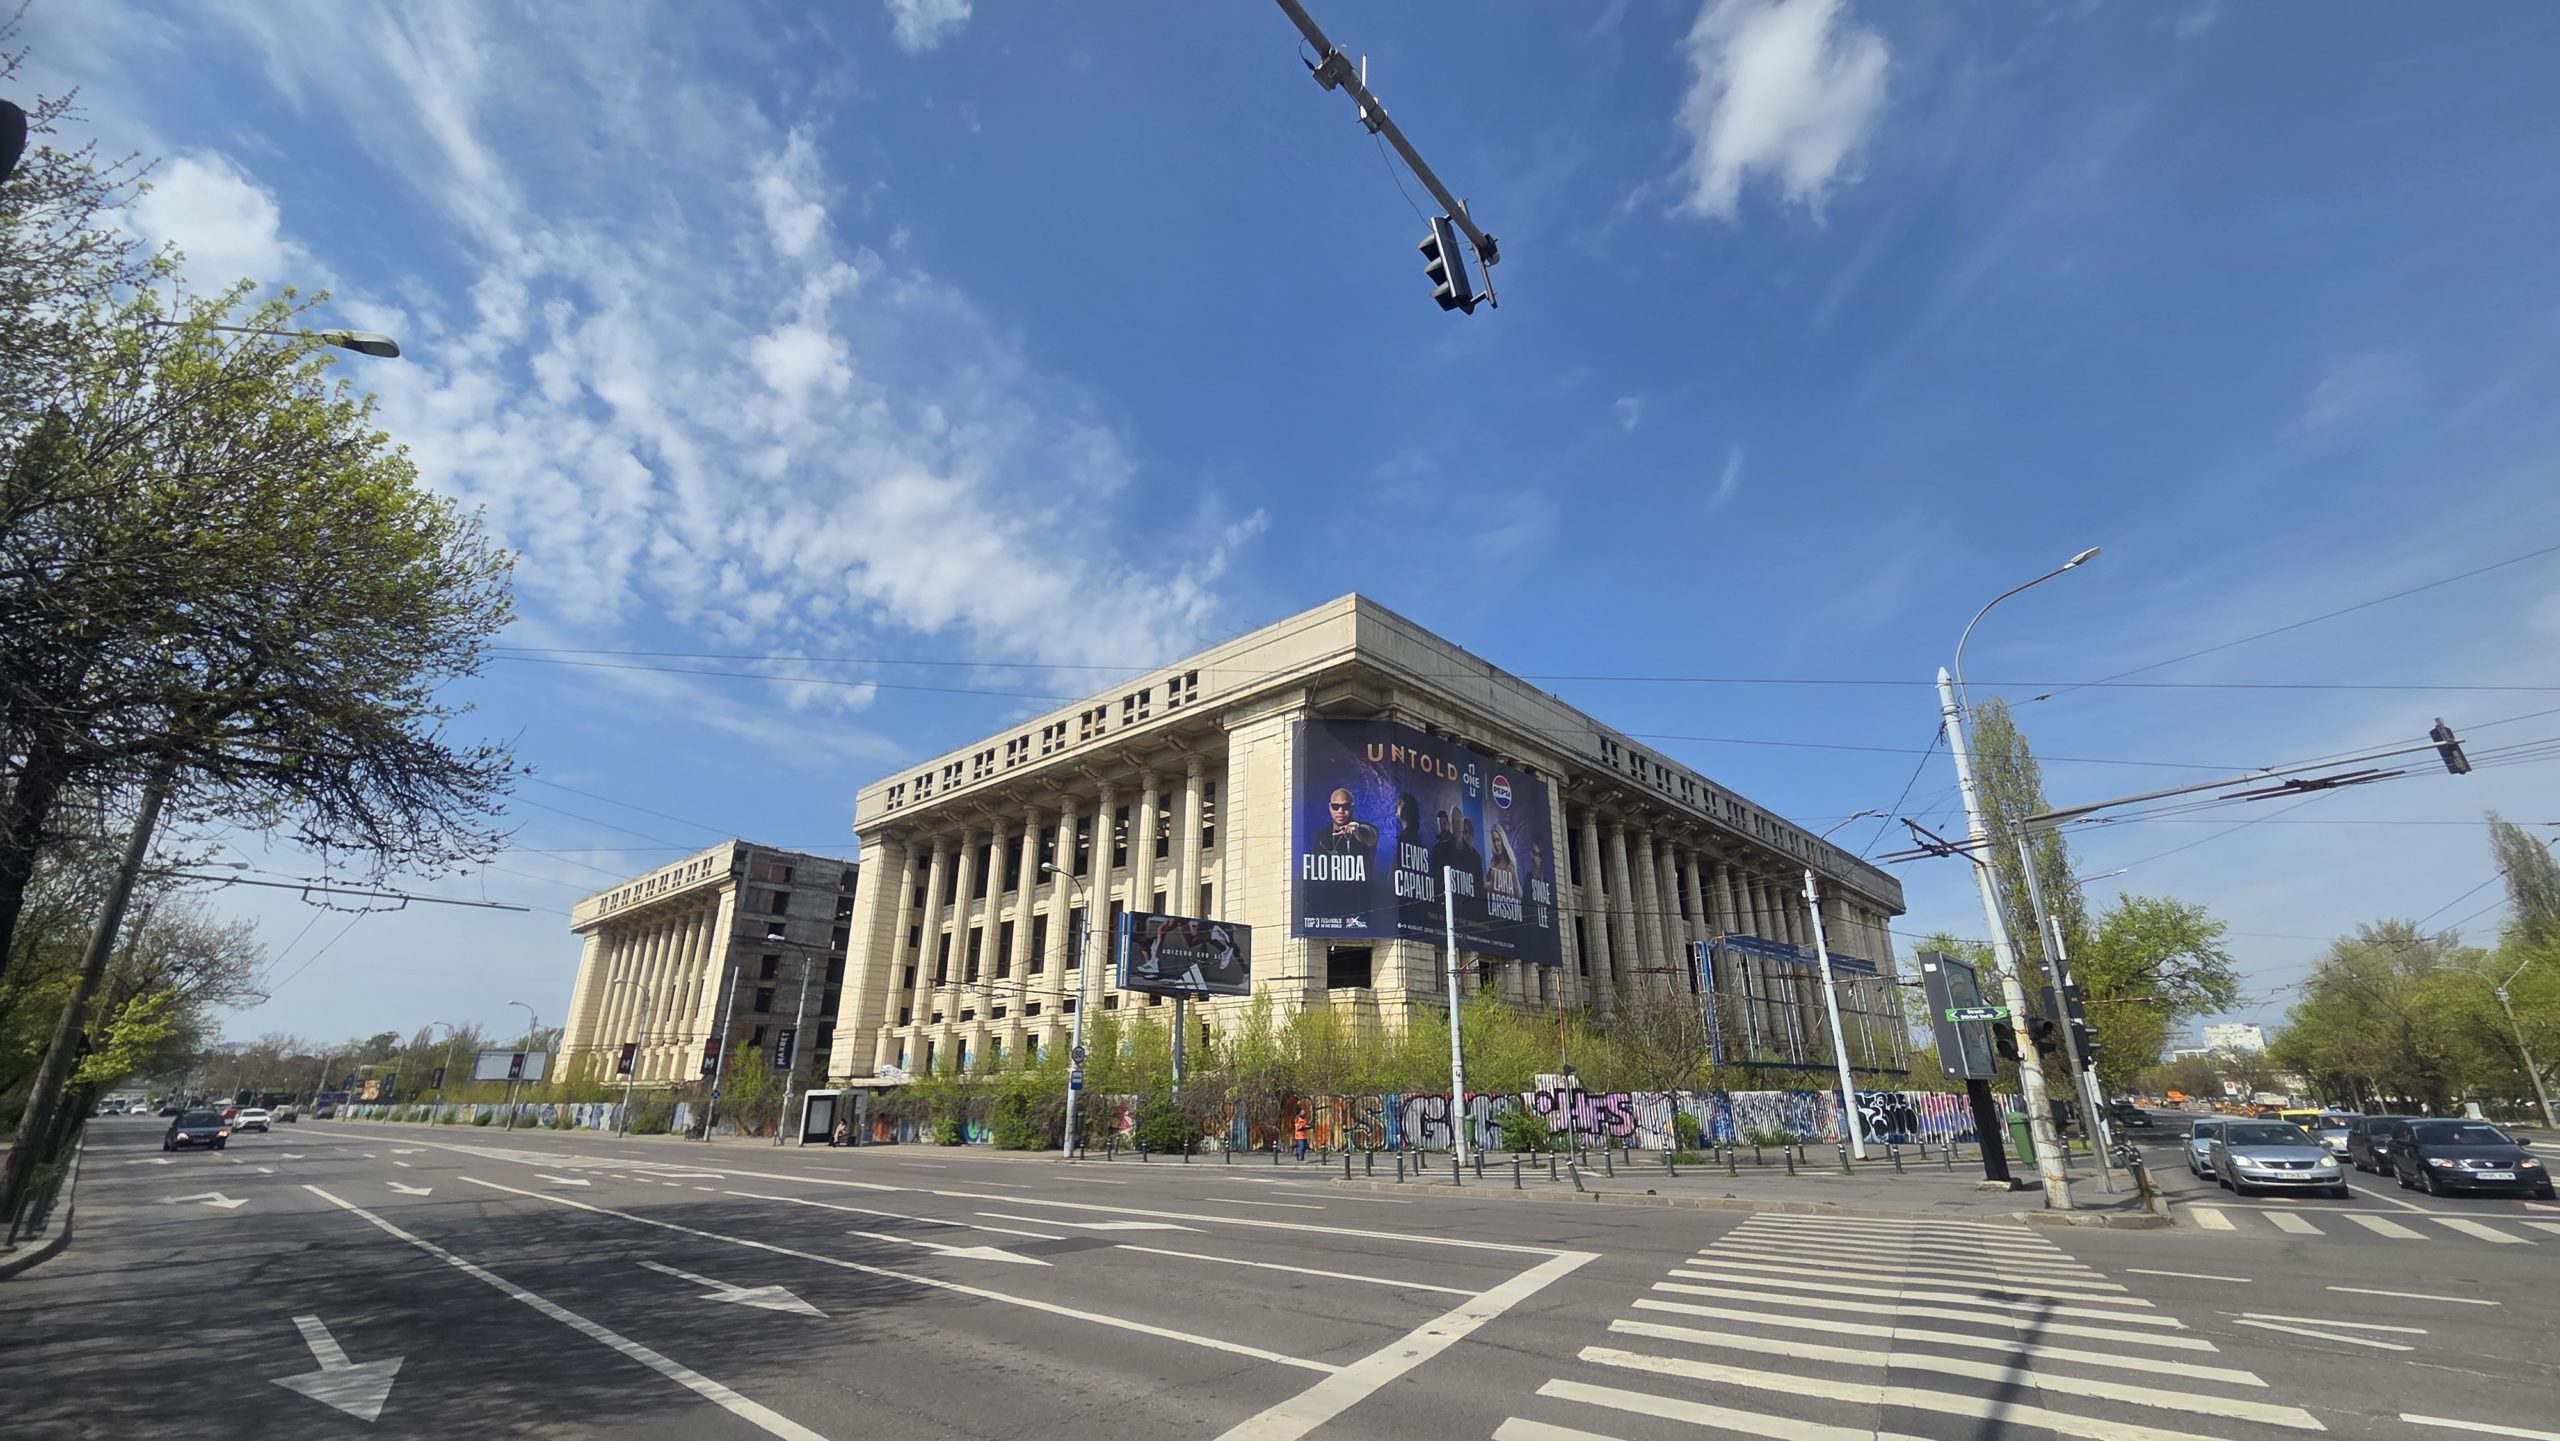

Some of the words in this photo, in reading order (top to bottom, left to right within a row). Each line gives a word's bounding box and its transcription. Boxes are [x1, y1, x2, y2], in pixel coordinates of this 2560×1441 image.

[1367, 743, 1458, 782] UNTOLD
[1493, 786, 1511, 798] PEPSI
[1303, 854, 1328, 881] FLO
[1331, 854, 1366, 882] RIDA
[1400, 842, 1429, 873] LEWIS
[1395, 869, 1435, 903] CAPALDI
[1450, 868, 1475, 897] STING
[1492, 868, 1514, 895] ZARA
[1531, 879, 1551, 905] SWAE
[1487, 892, 1523, 922] LARSSON
[1538, 905, 1550, 929] LEE
[1304, 917, 1315, 928] TOP
[1315, 917, 1320, 928] 3
[1162, 948, 1192, 957] ADIZERO
[777, 1031, 790, 1065] MAXBET
[1074, 1050, 1083, 1059] 50
[704, 1057, 714, 1069] M
